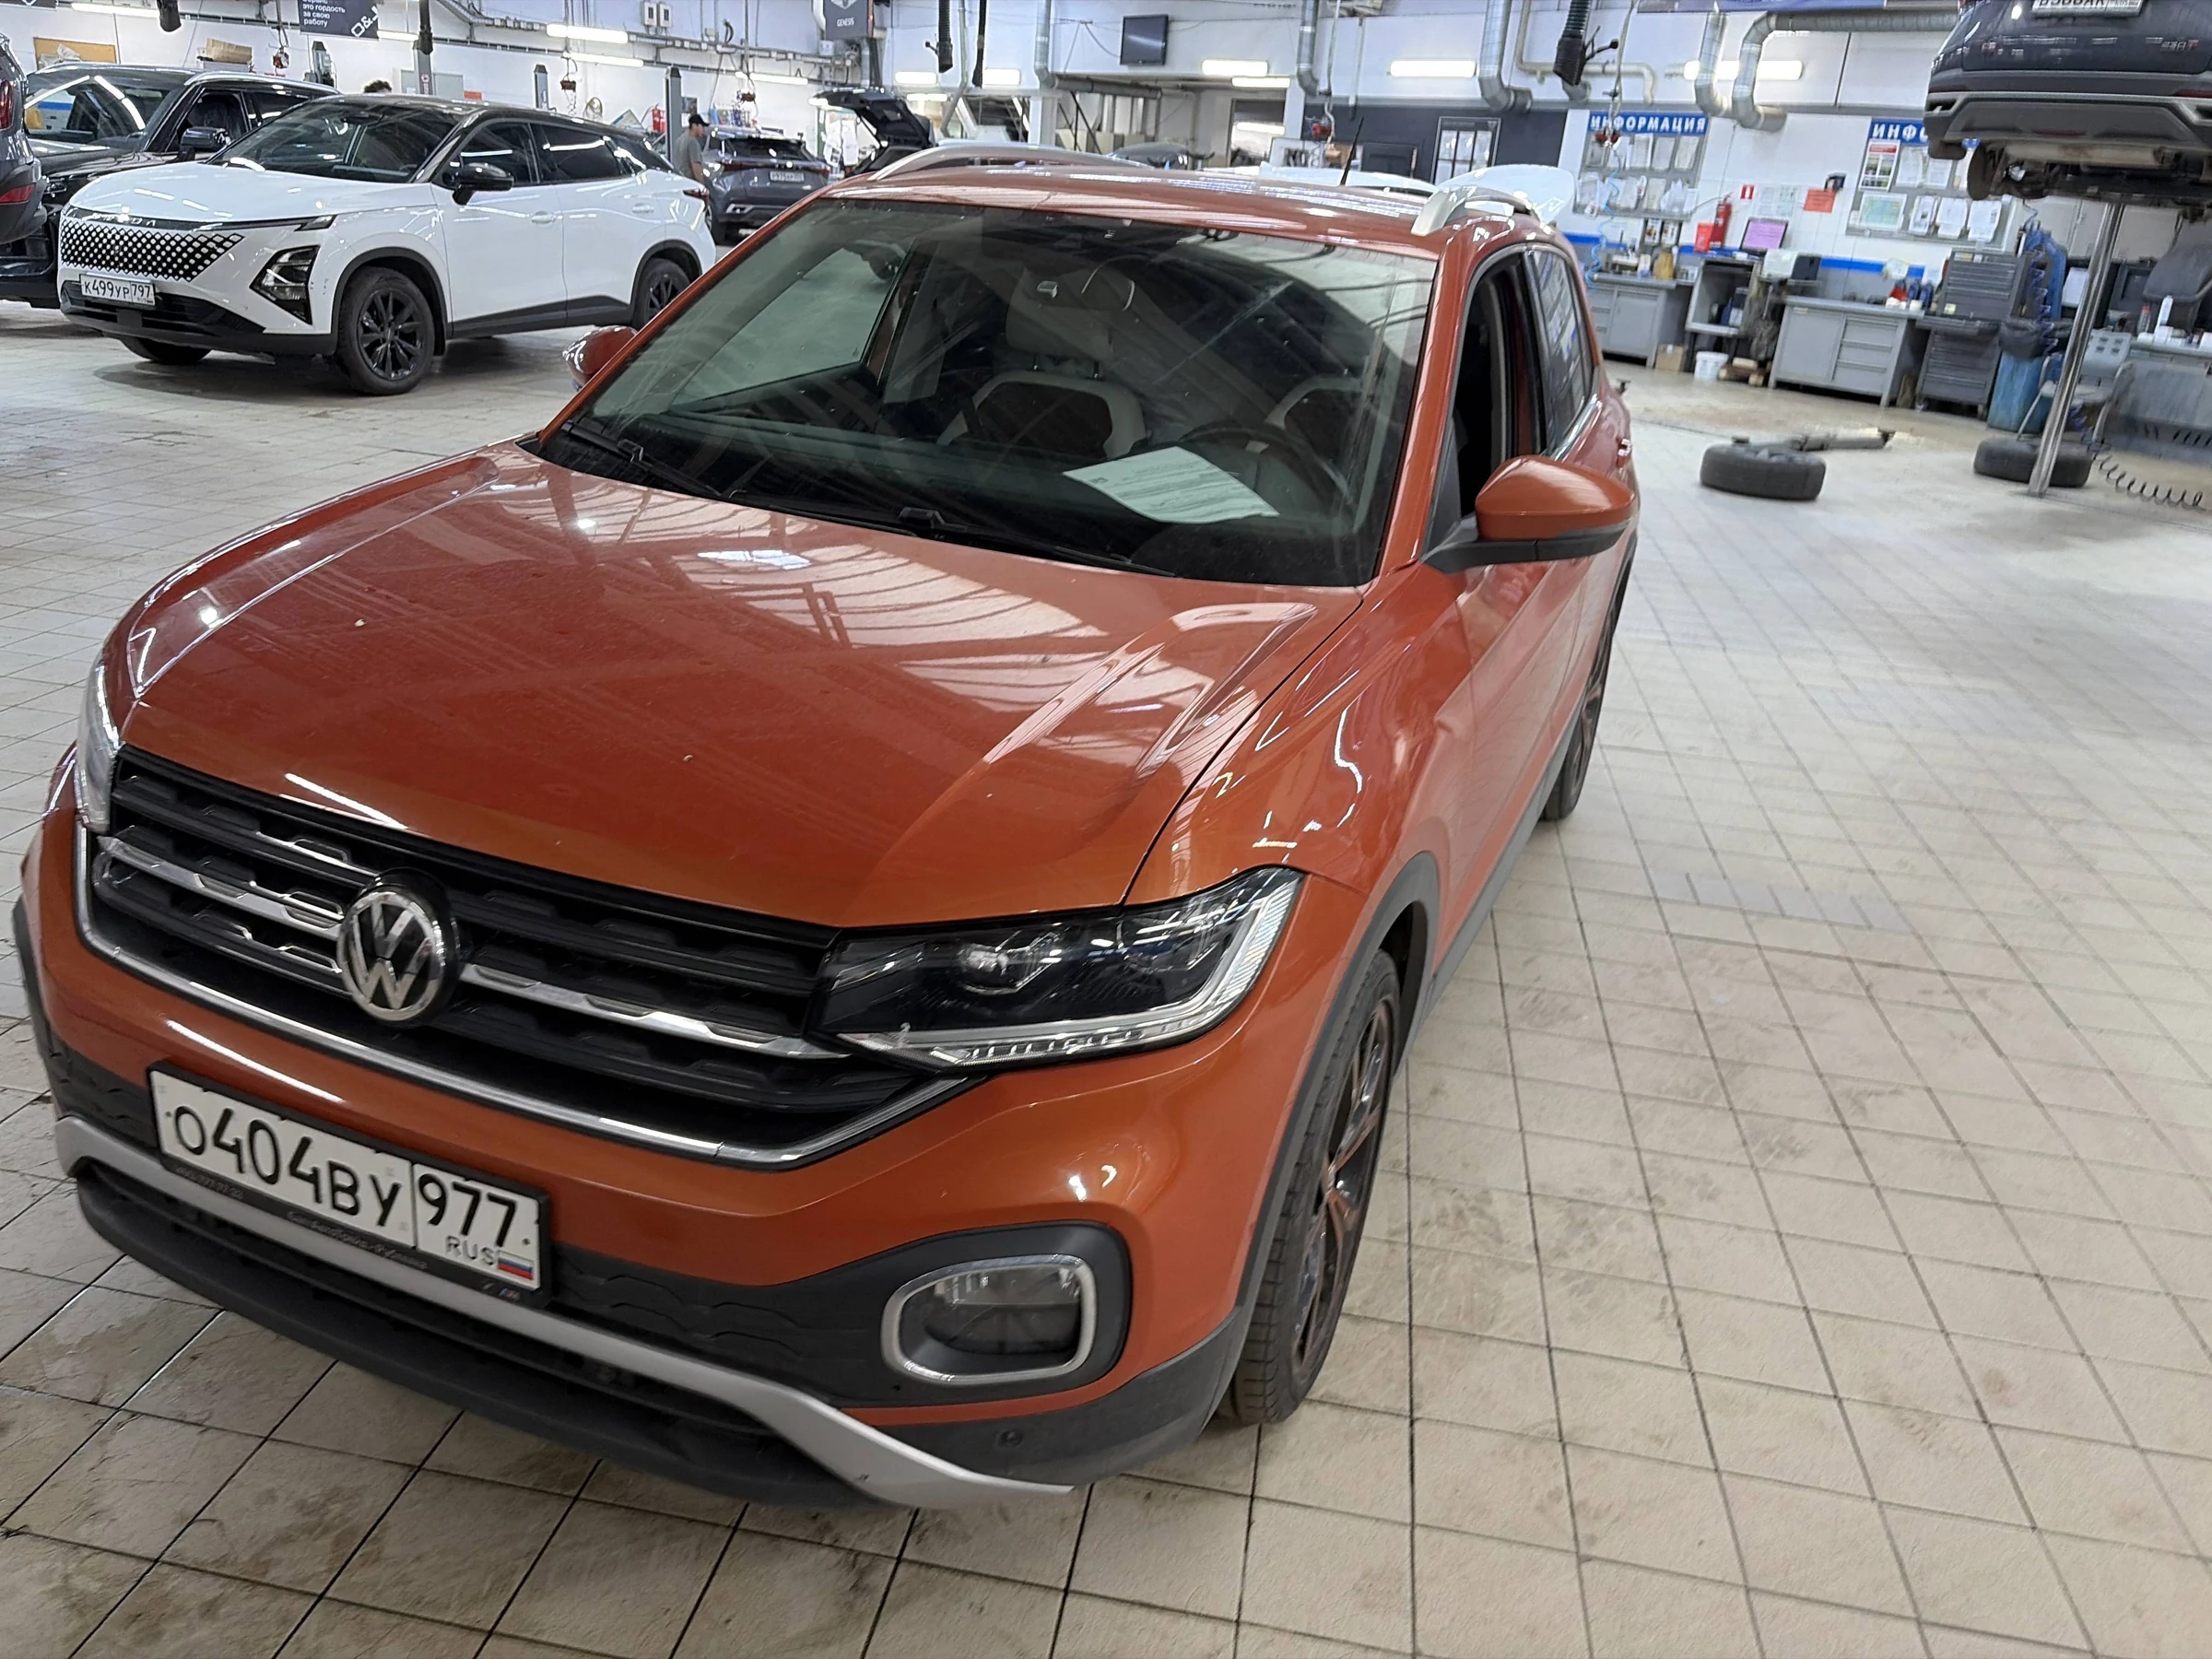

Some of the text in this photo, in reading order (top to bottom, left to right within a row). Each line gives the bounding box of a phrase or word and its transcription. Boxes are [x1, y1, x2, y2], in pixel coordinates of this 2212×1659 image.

[315, 5, 346, 13] гордость
[303, 18, 328, 28] работу
[1590, 116, 1706, 134] ИНФОРМАЦИЯ
[131, 283, 151, 299] 797
[418, 1172, 517, 1248] 977
[445, 1235, 495, 1265] RUS
